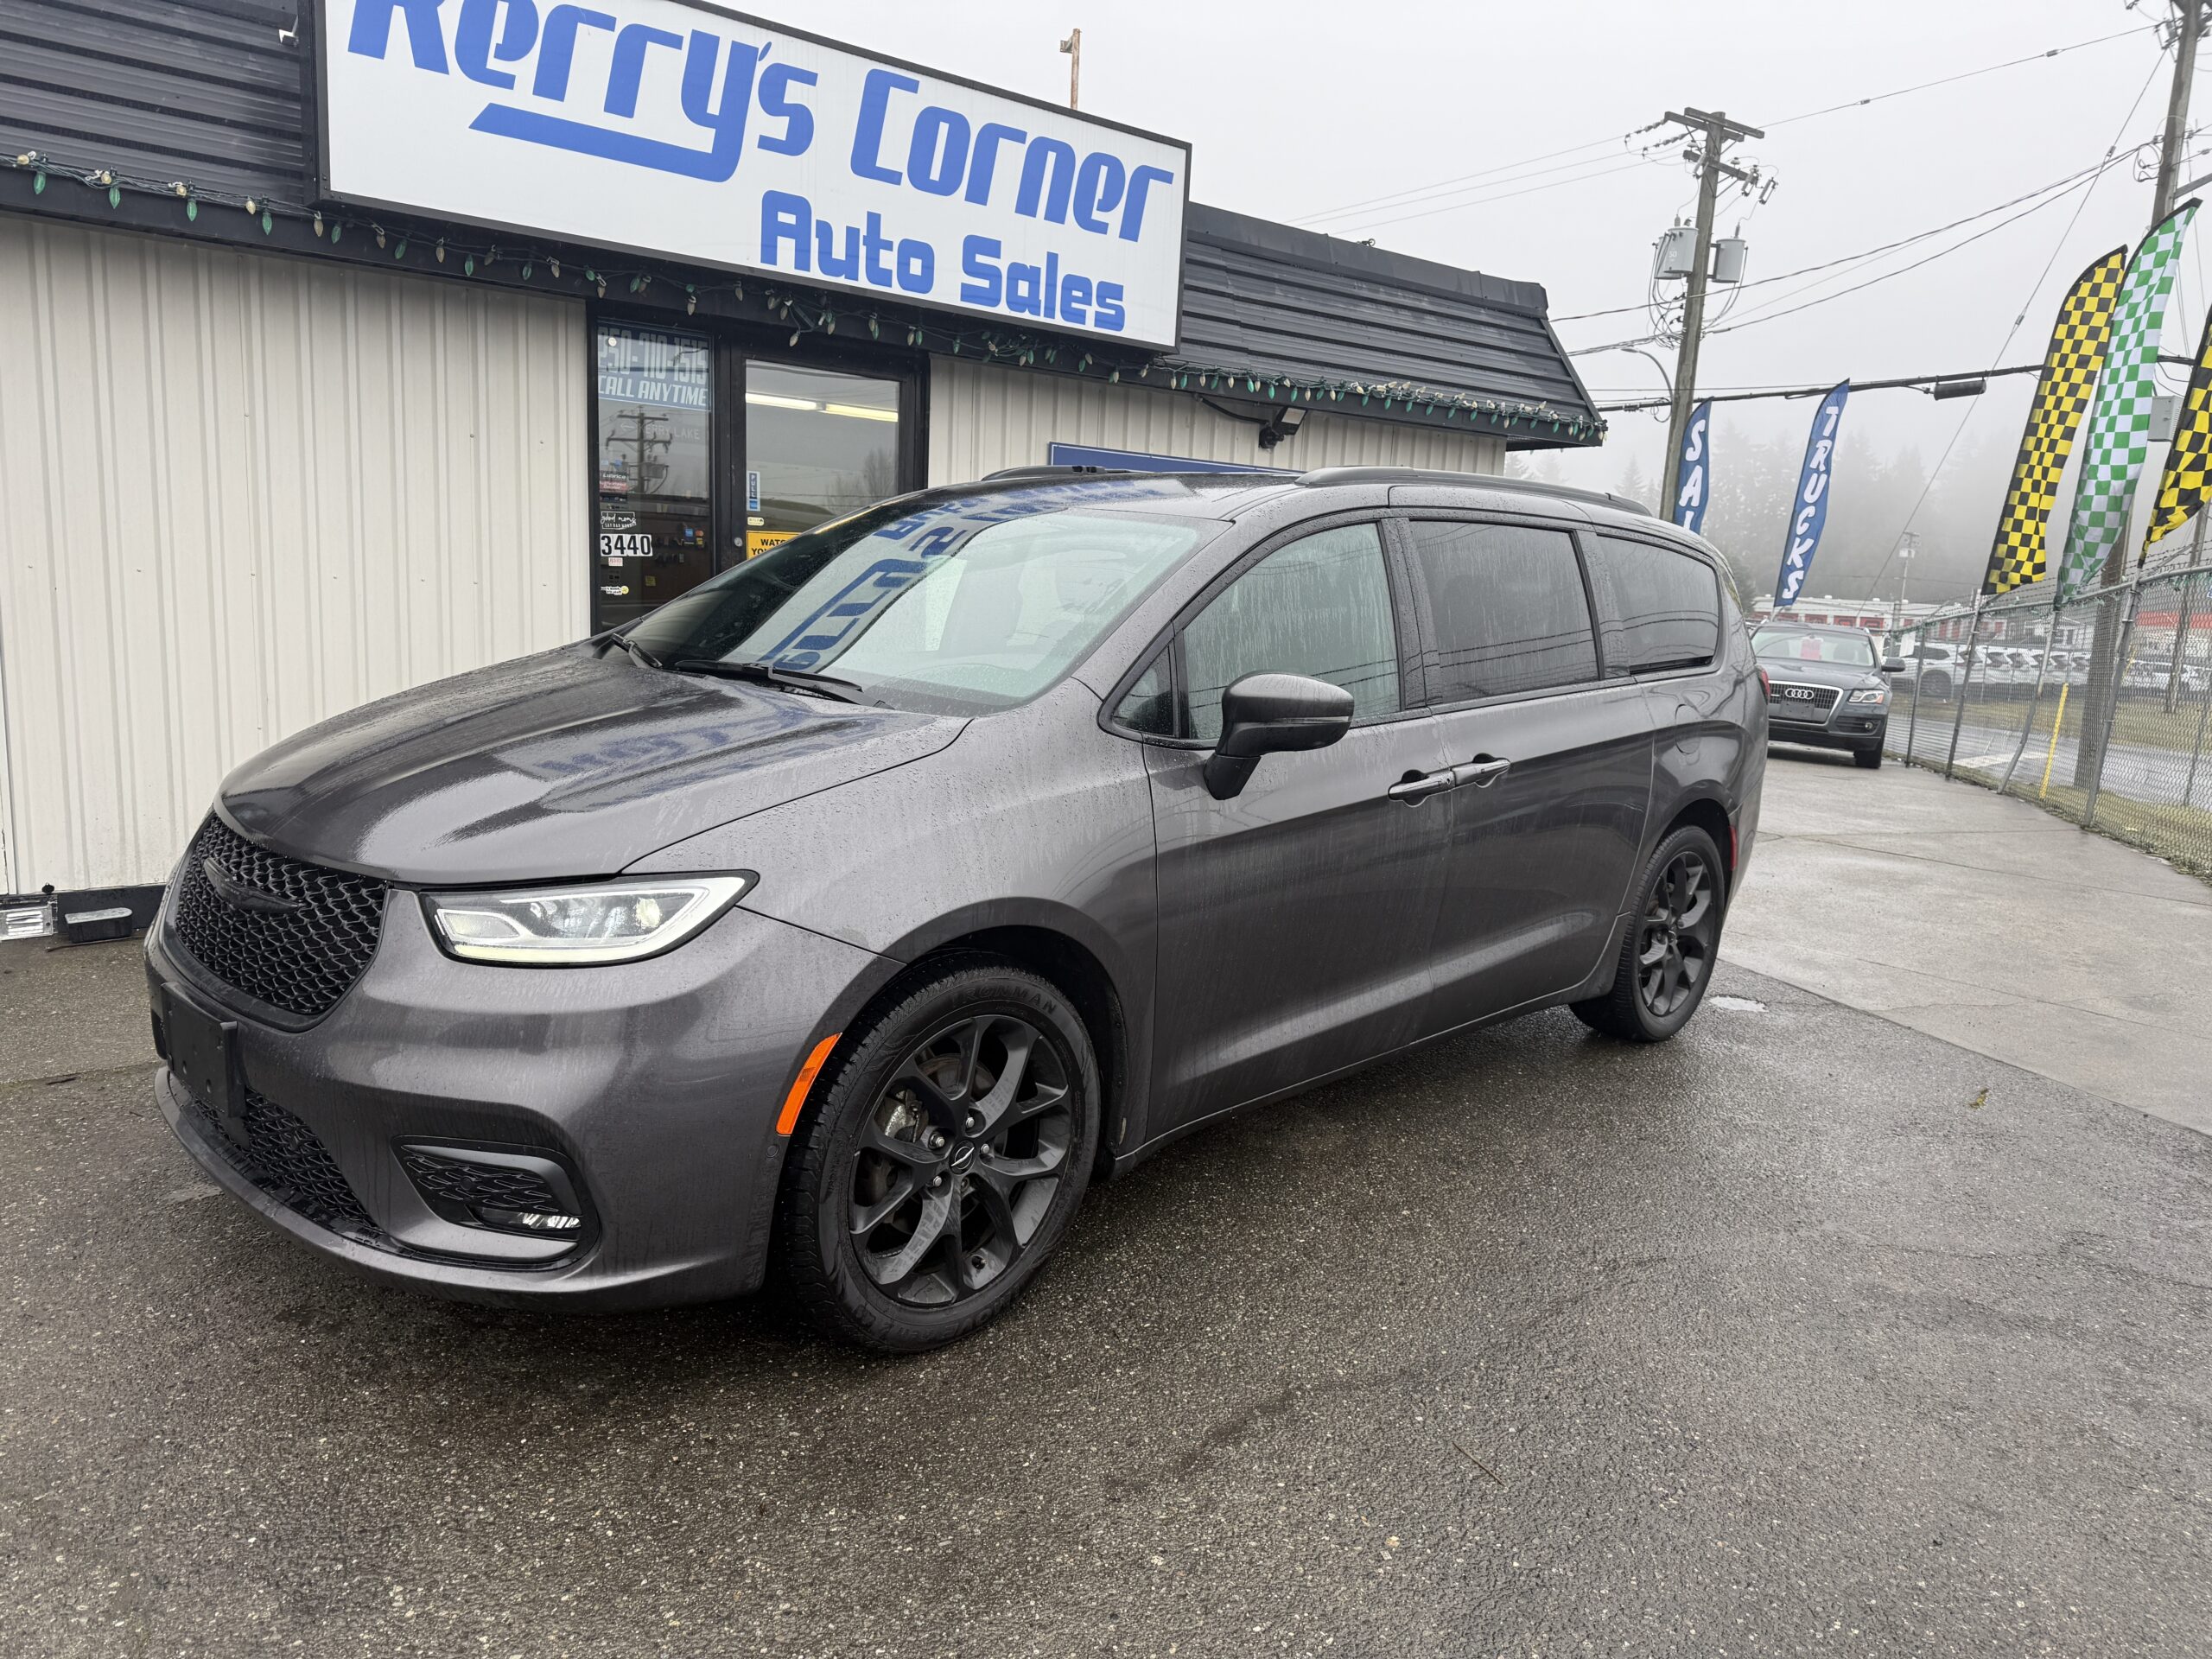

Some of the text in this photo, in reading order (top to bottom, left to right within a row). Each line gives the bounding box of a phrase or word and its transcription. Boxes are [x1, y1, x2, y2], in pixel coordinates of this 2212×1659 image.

[850, 68, 1174, 243] Corner
[760, 190, 1125, 332] Auto Sales
[599, 375, 709, 406] CALL ANYTIME
[601, 535, 652, 556] 3440
[1782, 406, 1839, 599] TRUCKS
